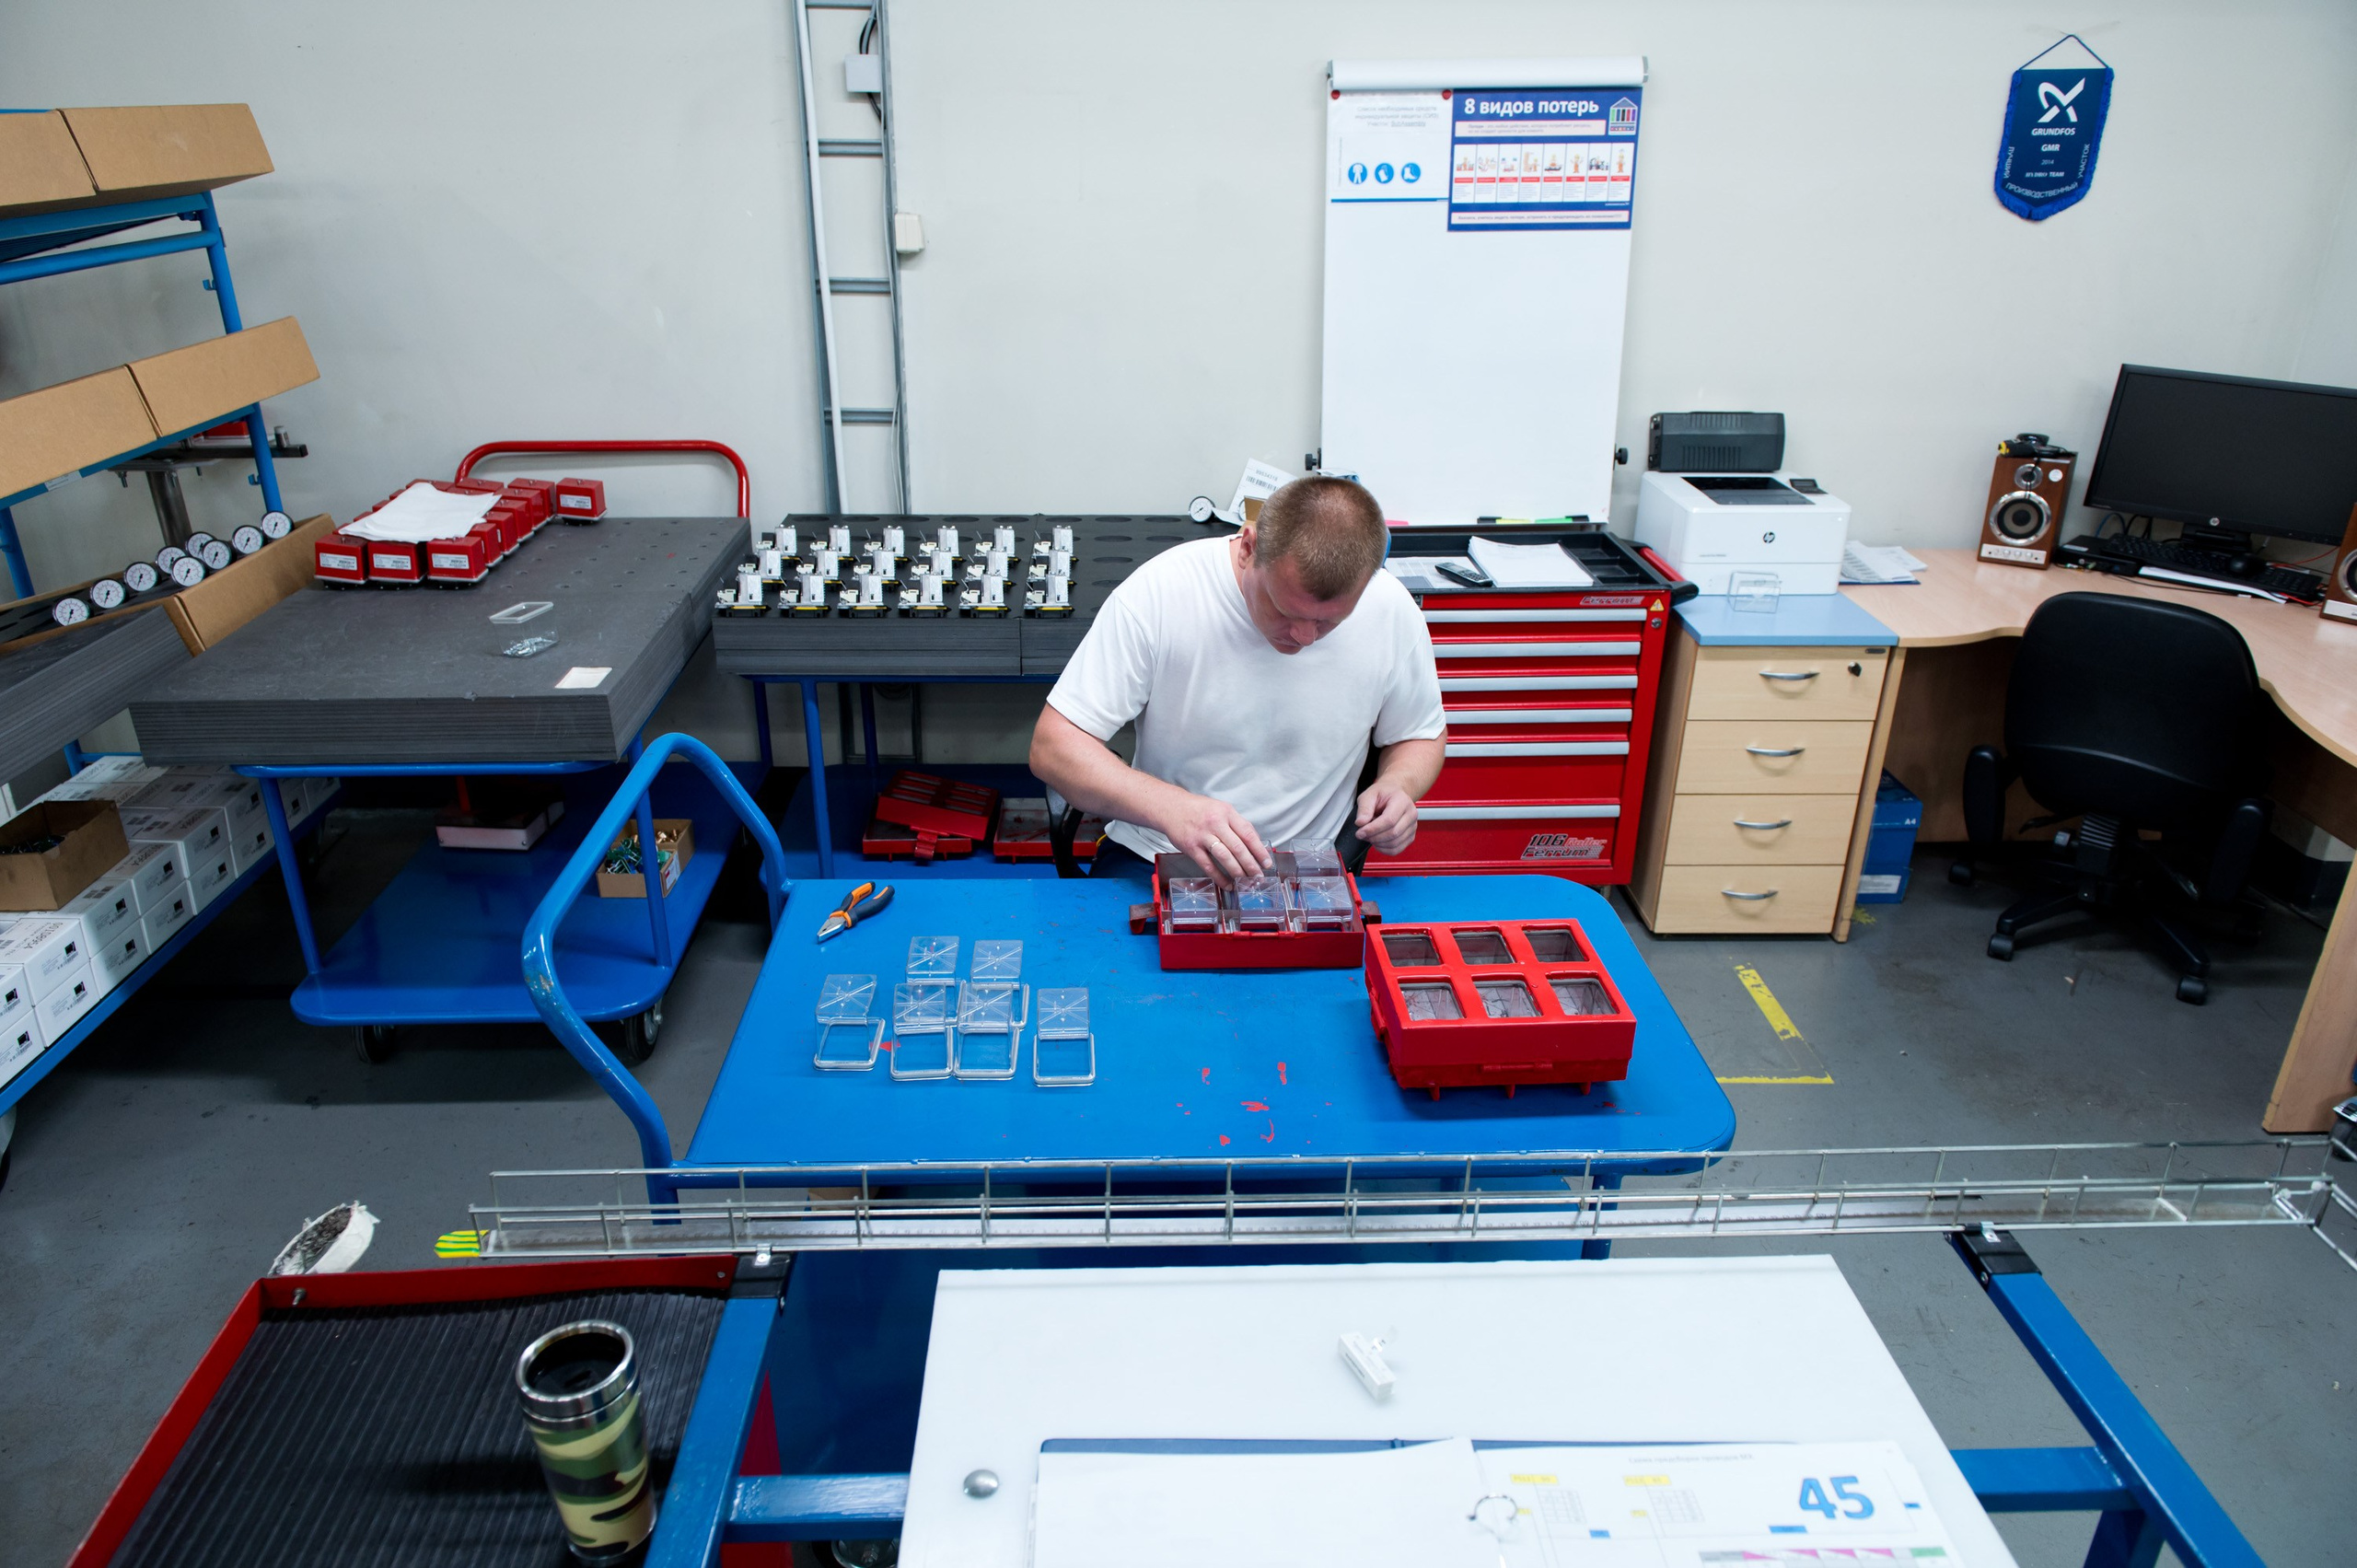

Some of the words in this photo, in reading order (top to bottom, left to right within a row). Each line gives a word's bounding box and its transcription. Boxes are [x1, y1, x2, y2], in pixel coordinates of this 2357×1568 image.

[1464, 98, 1476, 114] 8
[1480, 99, 1534, 117] видов
[1538, 99, 1599, 117] потерь
[2031, 127, 2076, 136] GRUNDFOS
[2040, 144, 2061, 152] GMR
[2077, 144, 2090, 179] УЧАСТОК
[2004, 181, 2079, 199] ПРОИЗВОДСТВЕННЫЙ
[1904, 818, 1917, 826] A4
[1529, 833, 1568, 847] 106
[1565, 837, 1608, 847] Roller
[1522, 846, 1590, 858] Ferrum
[1799, 1475, 1875, 1519] 45
